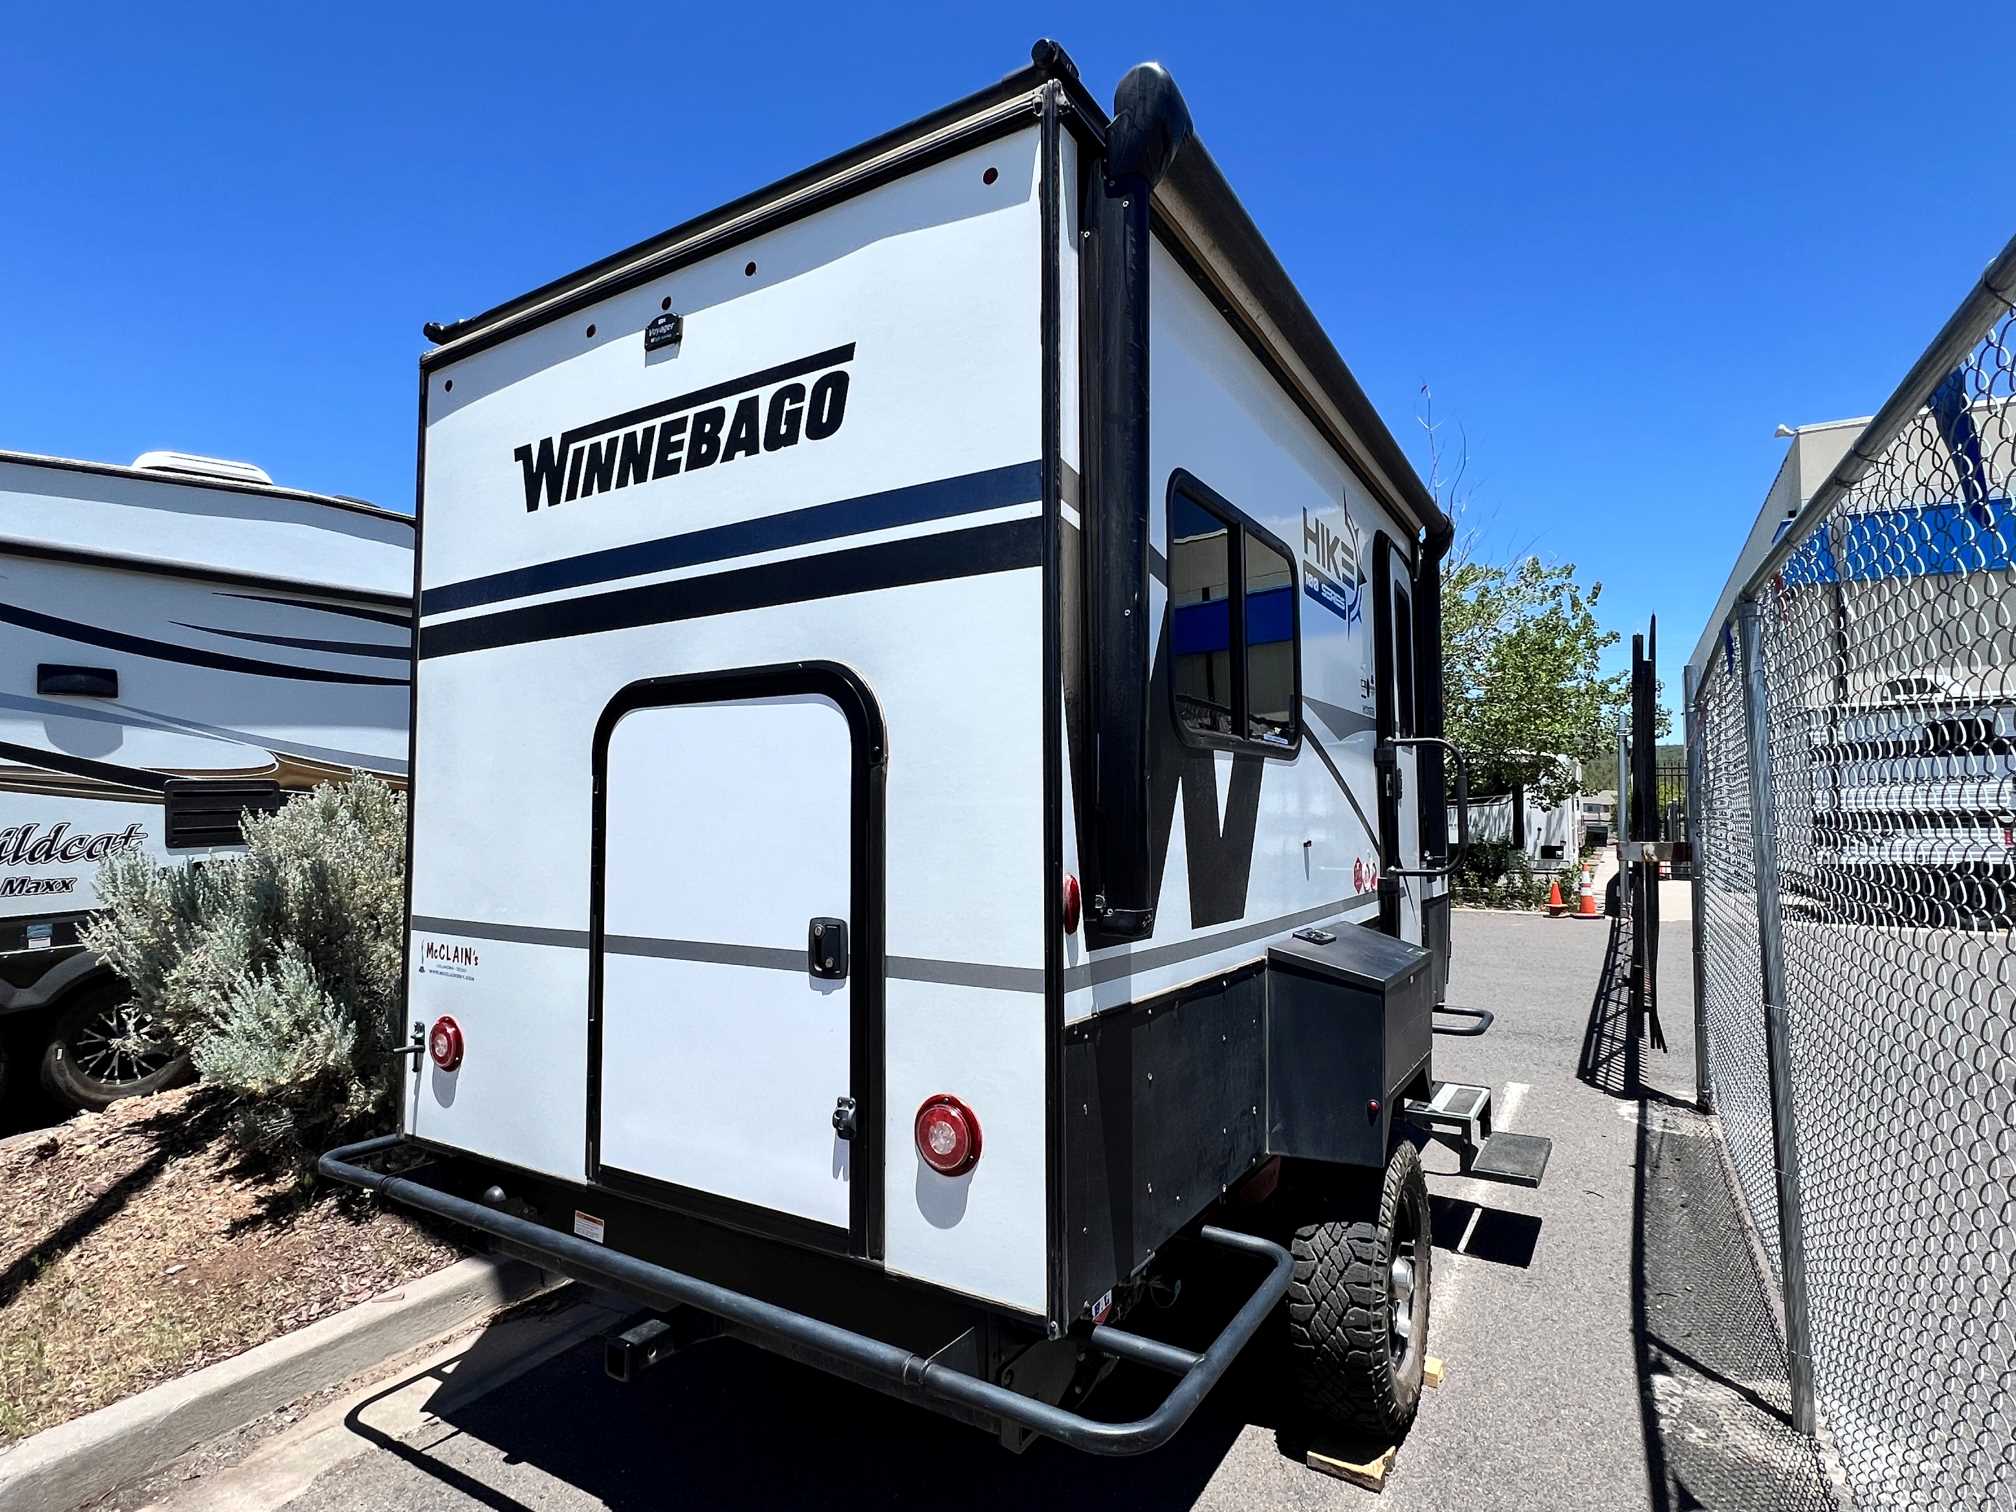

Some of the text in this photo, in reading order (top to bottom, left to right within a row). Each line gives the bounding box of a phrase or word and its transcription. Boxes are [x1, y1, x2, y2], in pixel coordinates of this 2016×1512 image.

[513, 368, 852, 513] WINNEBAGO
[1302, 506, 1356, 591] HIKE
[0, 822, 148, 866] ildcat
[0, 876, 77, 897] Maxx
[426, 942, 479, 966] McCLAIN's
